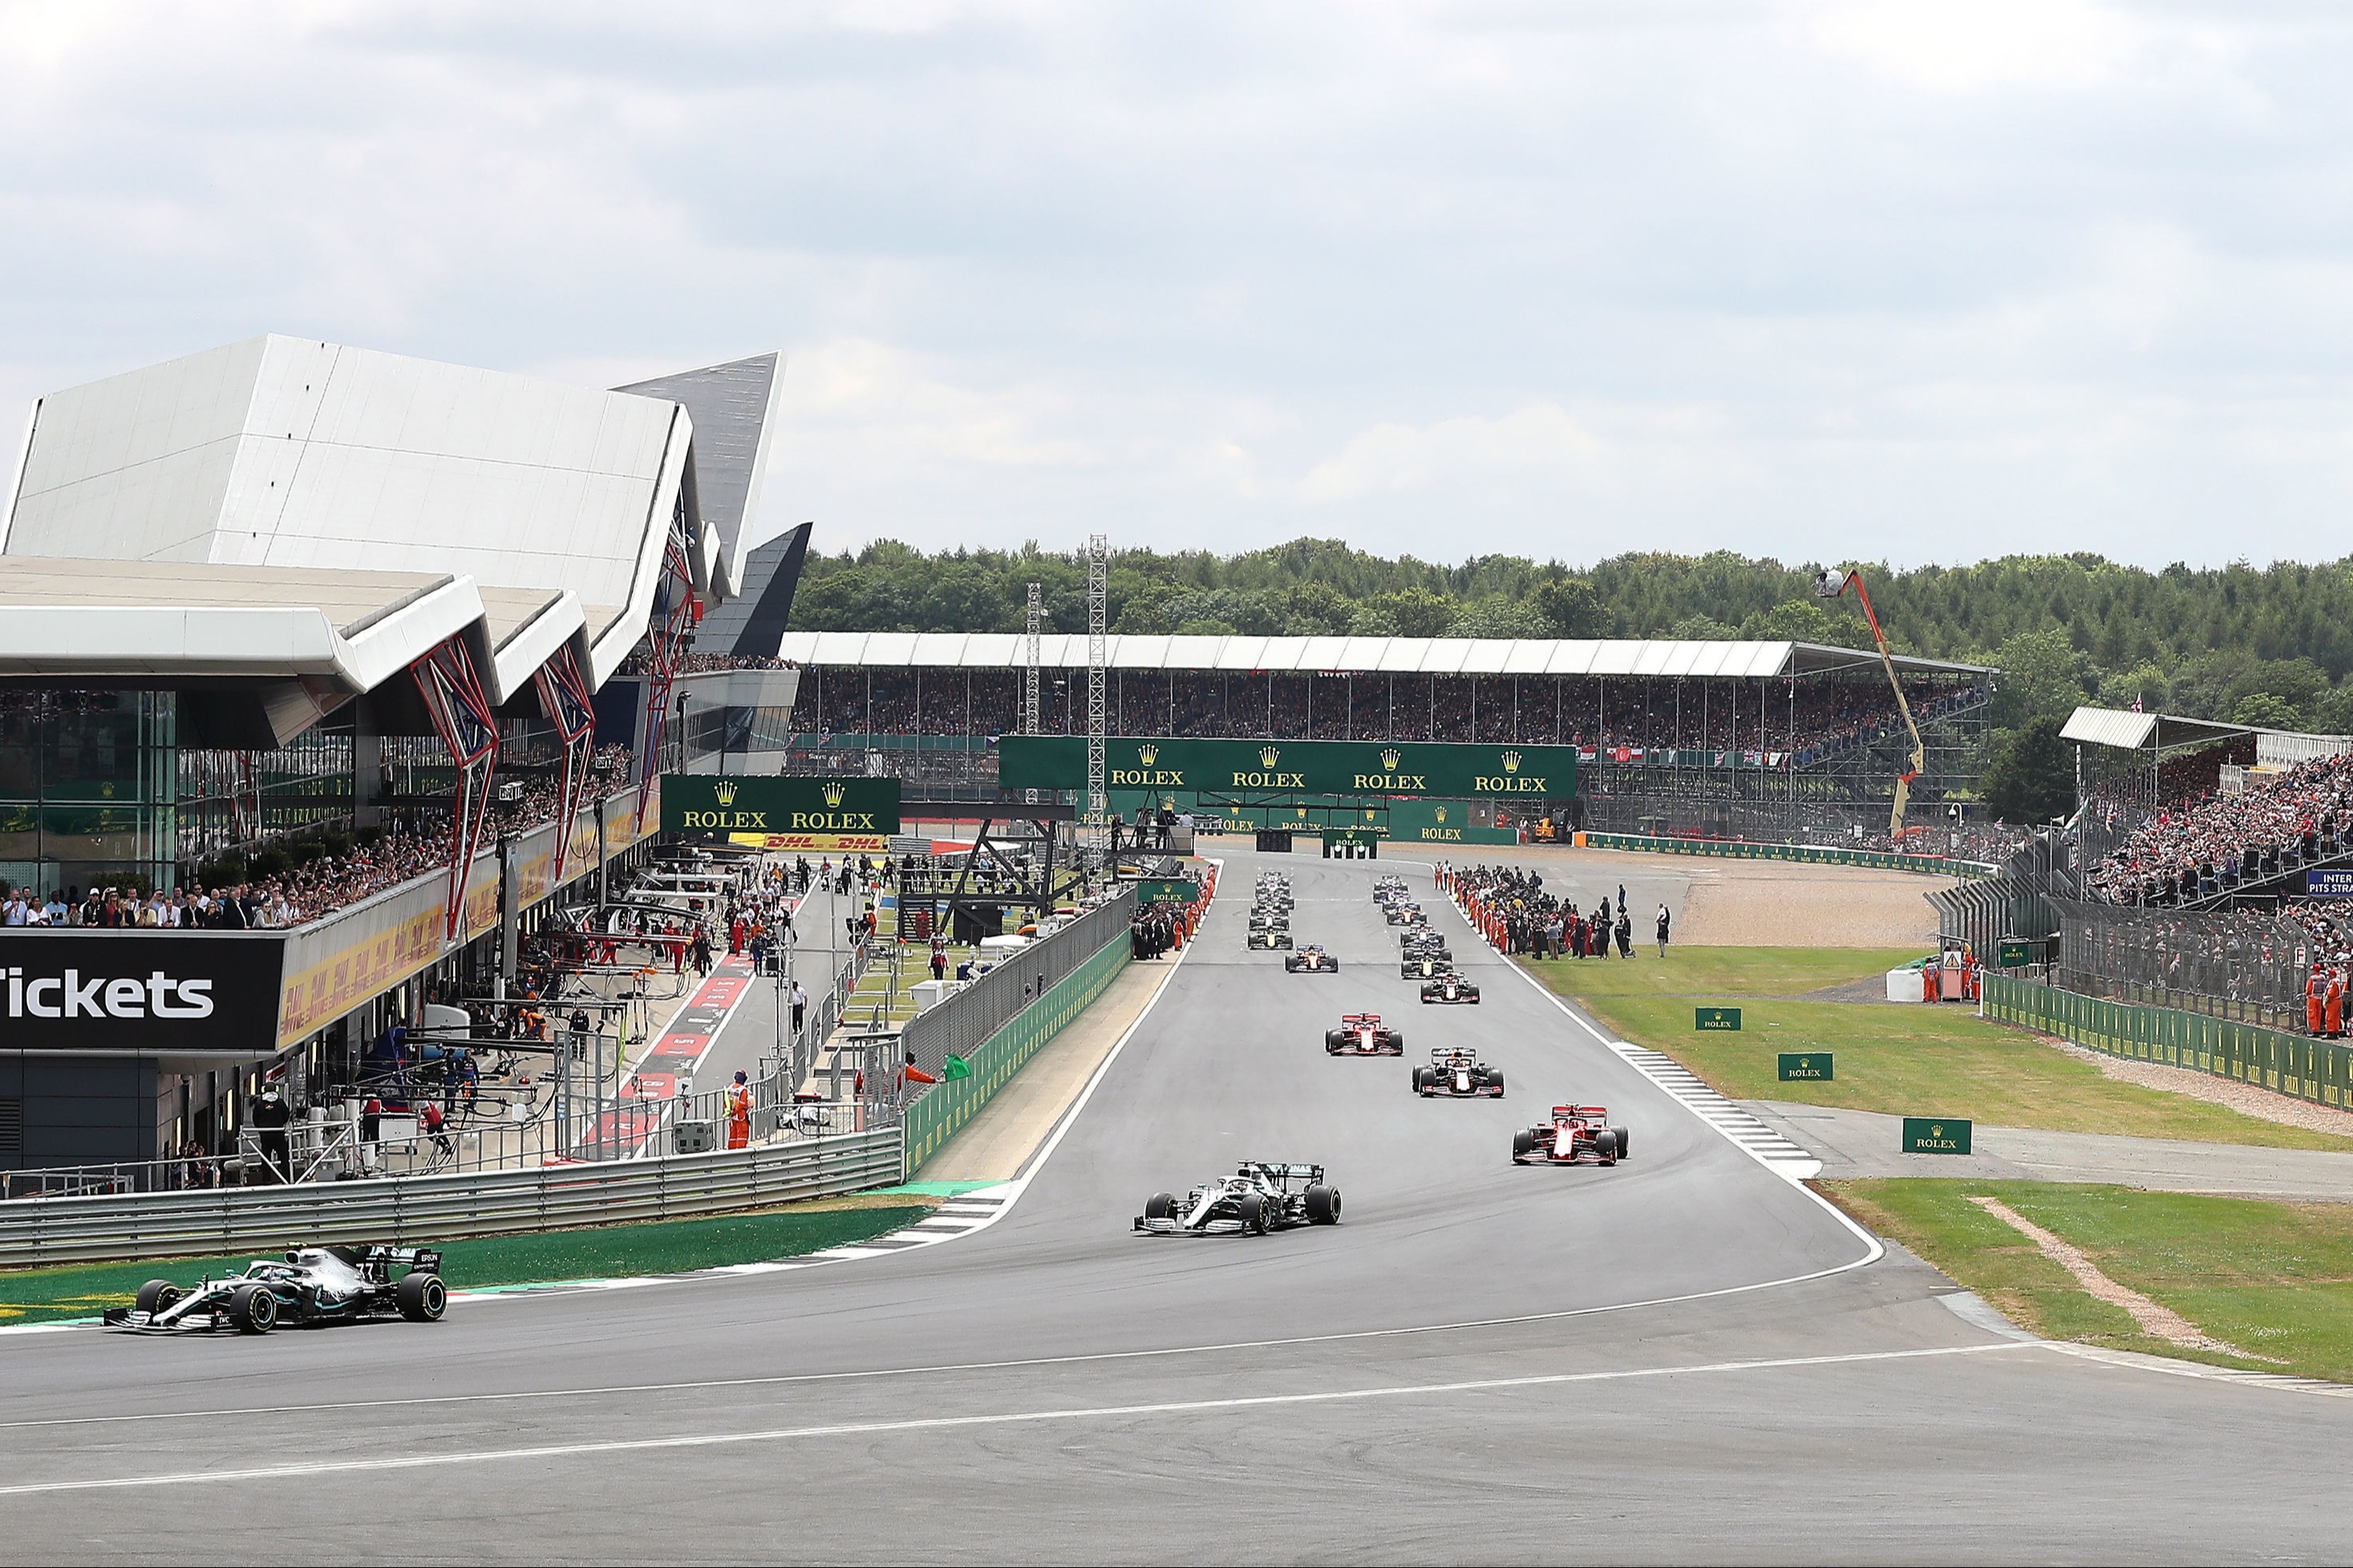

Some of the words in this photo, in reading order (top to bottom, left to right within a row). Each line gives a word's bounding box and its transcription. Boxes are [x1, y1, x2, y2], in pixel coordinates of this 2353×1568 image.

[1112, 770, 1185, 785] ROLEX
[1232, 772, 1305, 788] ROLEX
[1353, 775, 1427, 790] ROLEX
[1474, 776, 1547, 792] ROLEX
[683, 811, 767, 829] ROLEX
[791, 812, 876, 829] ROLEX
[1223, 820, 1254, 832] OLEX
[1421, 827, 1462, 841] ROLEX
[766, 836, 816, 849] DHL
[837, 837, 883, 849] DHL
[2323, 873, 2352, 883] INTER
[2310, 883, 2329, 893] PITS
[1153, 893, 1183, 901] ROLEX
[2296, 948, 2305, 962] F
[1788, 1069, 1820, 1077] ROLEX
[1916, 1138, 1957, 1149] ROLEX
[421, 1254, 438, 1262] EPSON
[356, 1262, 375, 1281] 77
